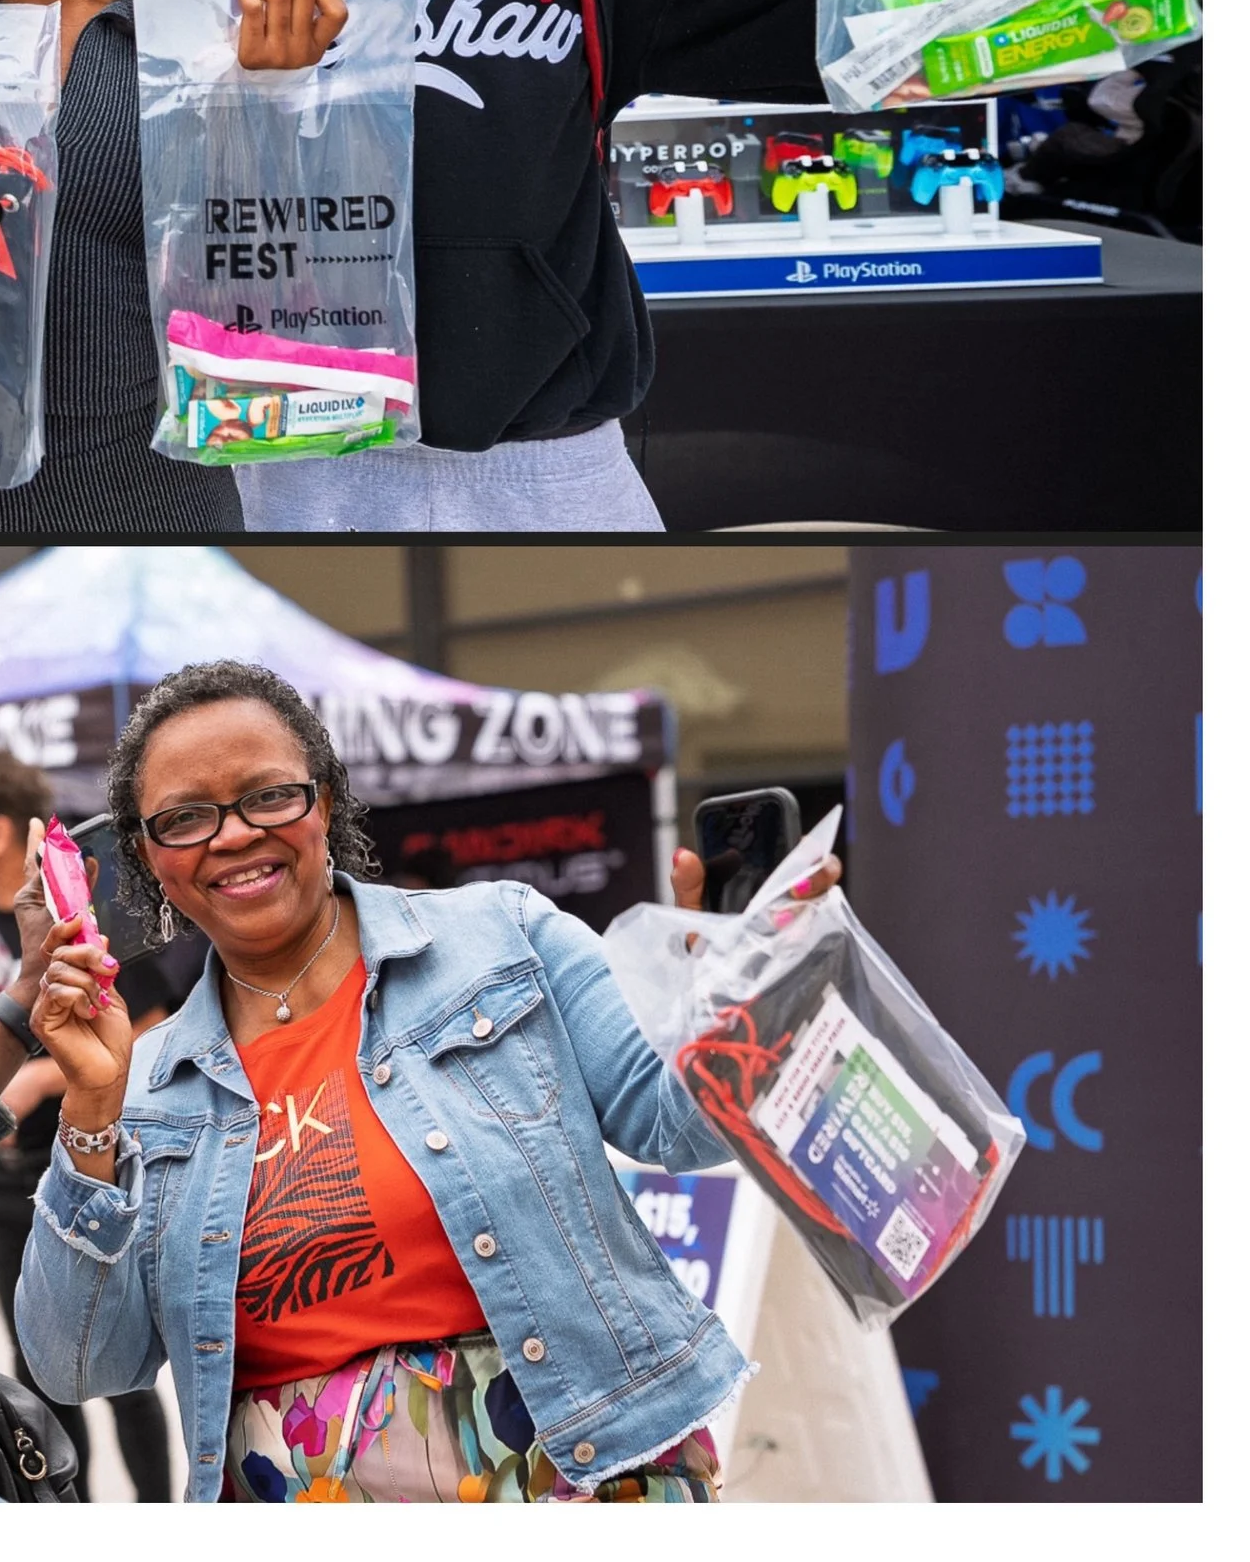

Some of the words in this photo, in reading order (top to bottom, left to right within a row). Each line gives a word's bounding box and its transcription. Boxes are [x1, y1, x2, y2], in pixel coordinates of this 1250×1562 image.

[997, 25, 1092, 67] ENERGY
[206, 194, 396, 234] REWIRED
[206, 242, 298, 280] FEST
[823, 260, 923, 283] PlayStation
[299, 400, 340, 415] LIQUID
[320, 690, 461, 766] ING
[471, 691, 644, 766] ZONE
